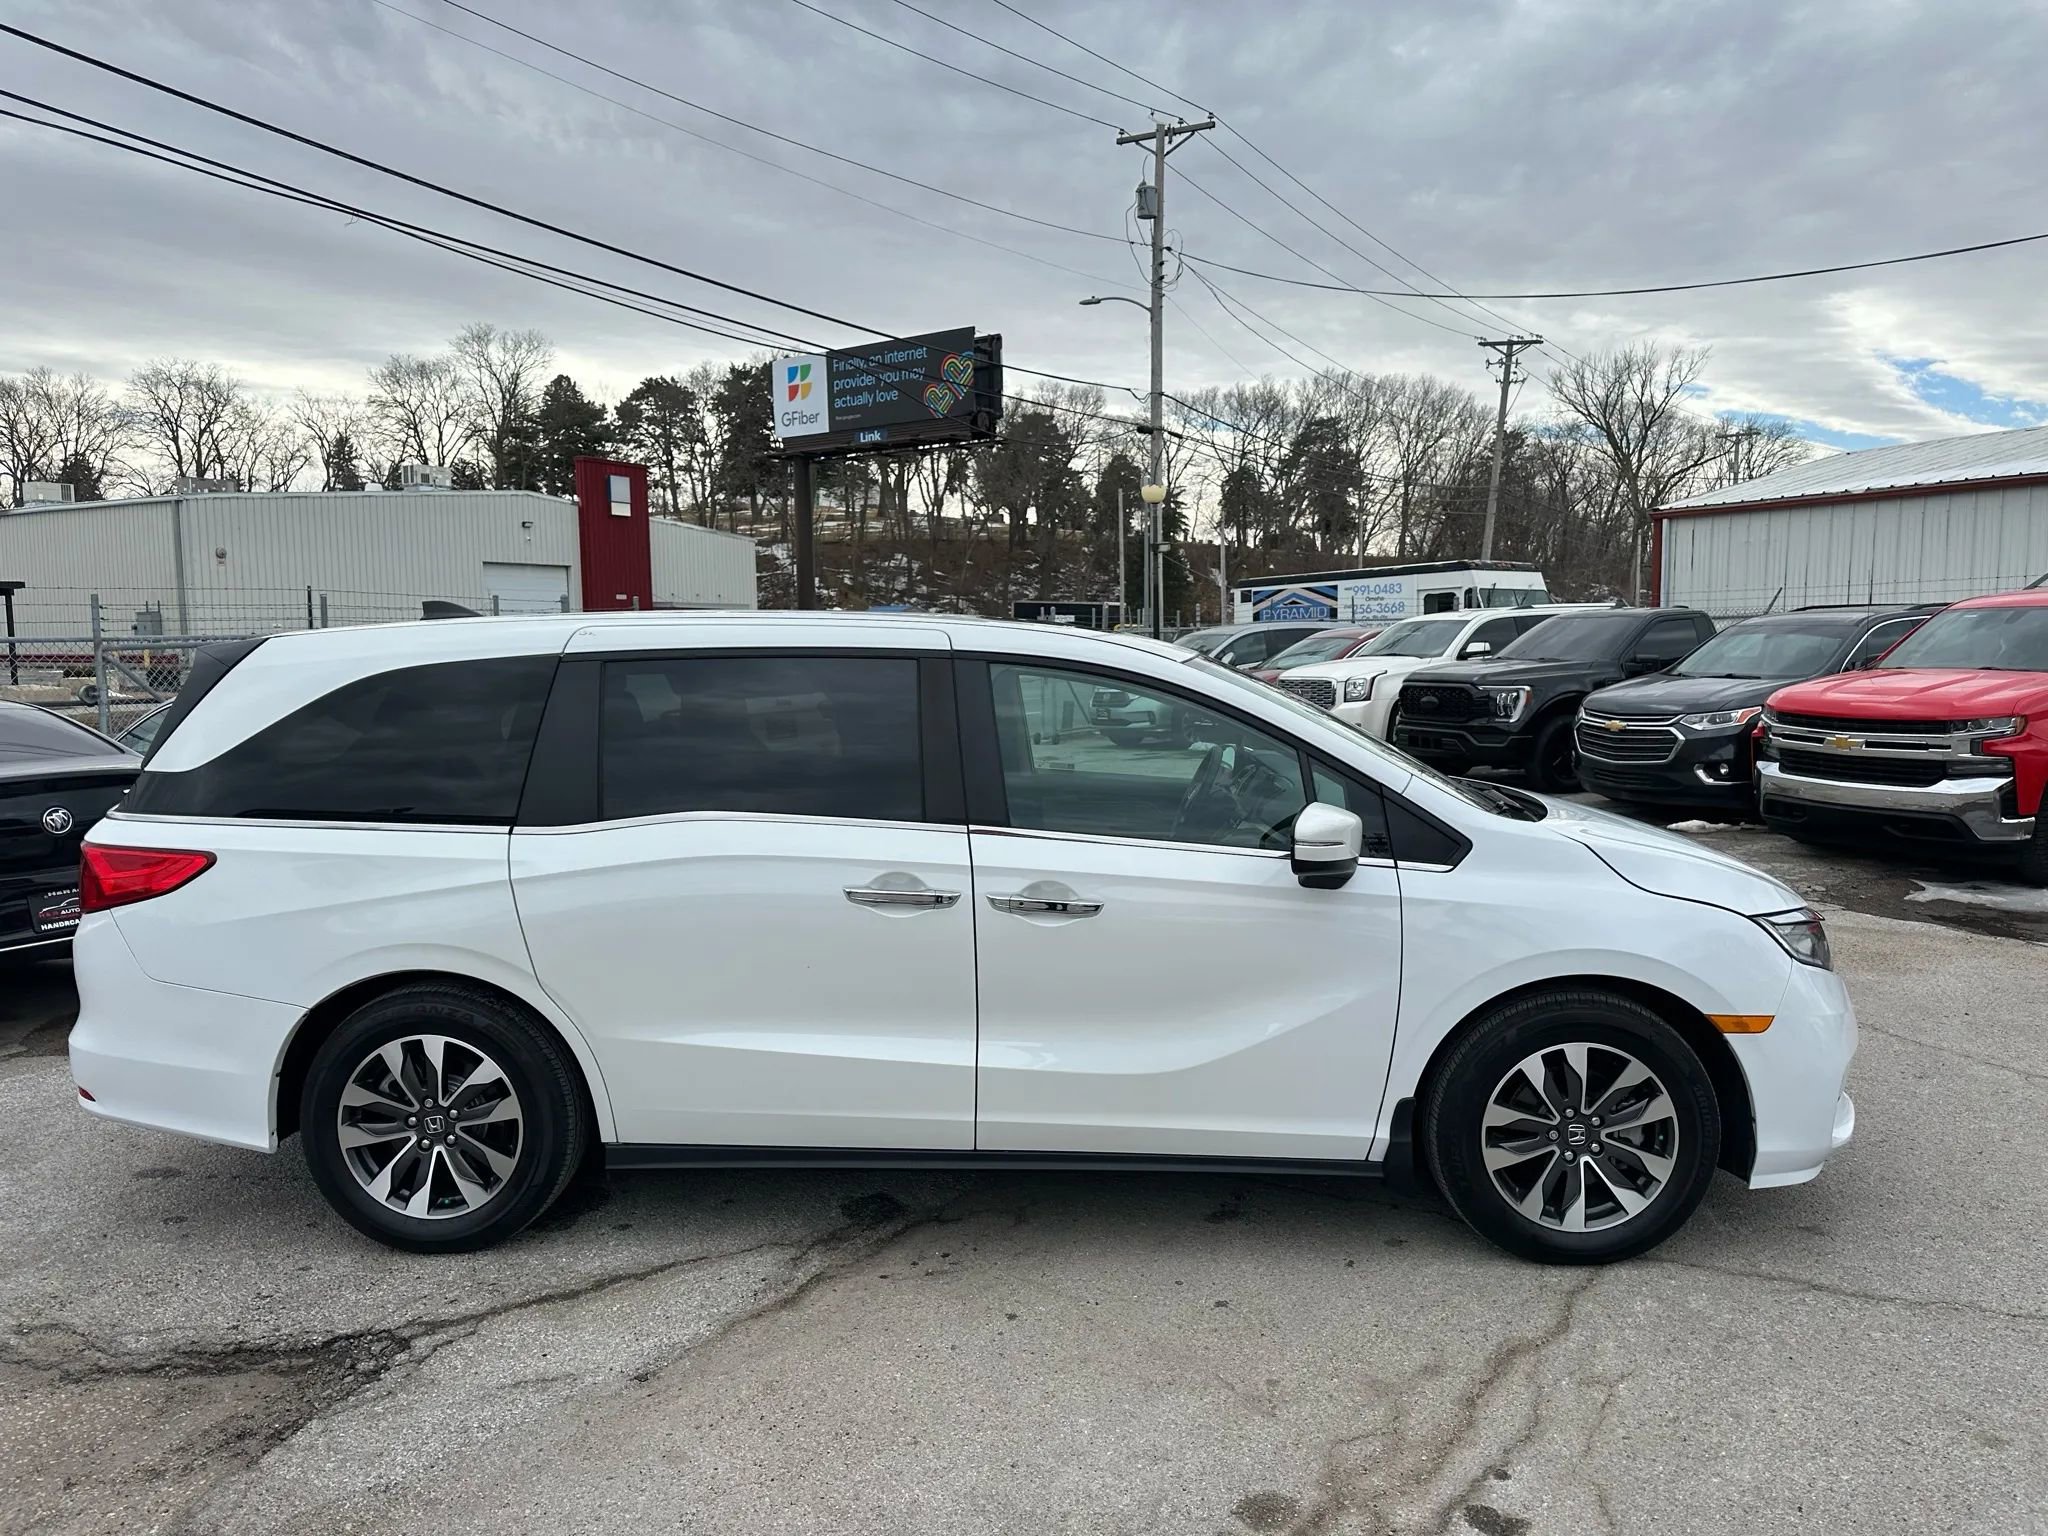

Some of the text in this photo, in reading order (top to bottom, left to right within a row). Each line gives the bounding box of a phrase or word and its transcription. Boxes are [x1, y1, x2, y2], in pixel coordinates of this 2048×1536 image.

[869, 355, 882, 366] an
[884, 347, 928, 364] internet
[833, 373, 876, 393] provider
[880, 371, 899, 387] you
[834, 389, 899, 408] actually love
[781, 410, 820, 427] GFiber
[860, 430, 881, 443] Link
[1262, 607, 1327, 620] PYRAMID
